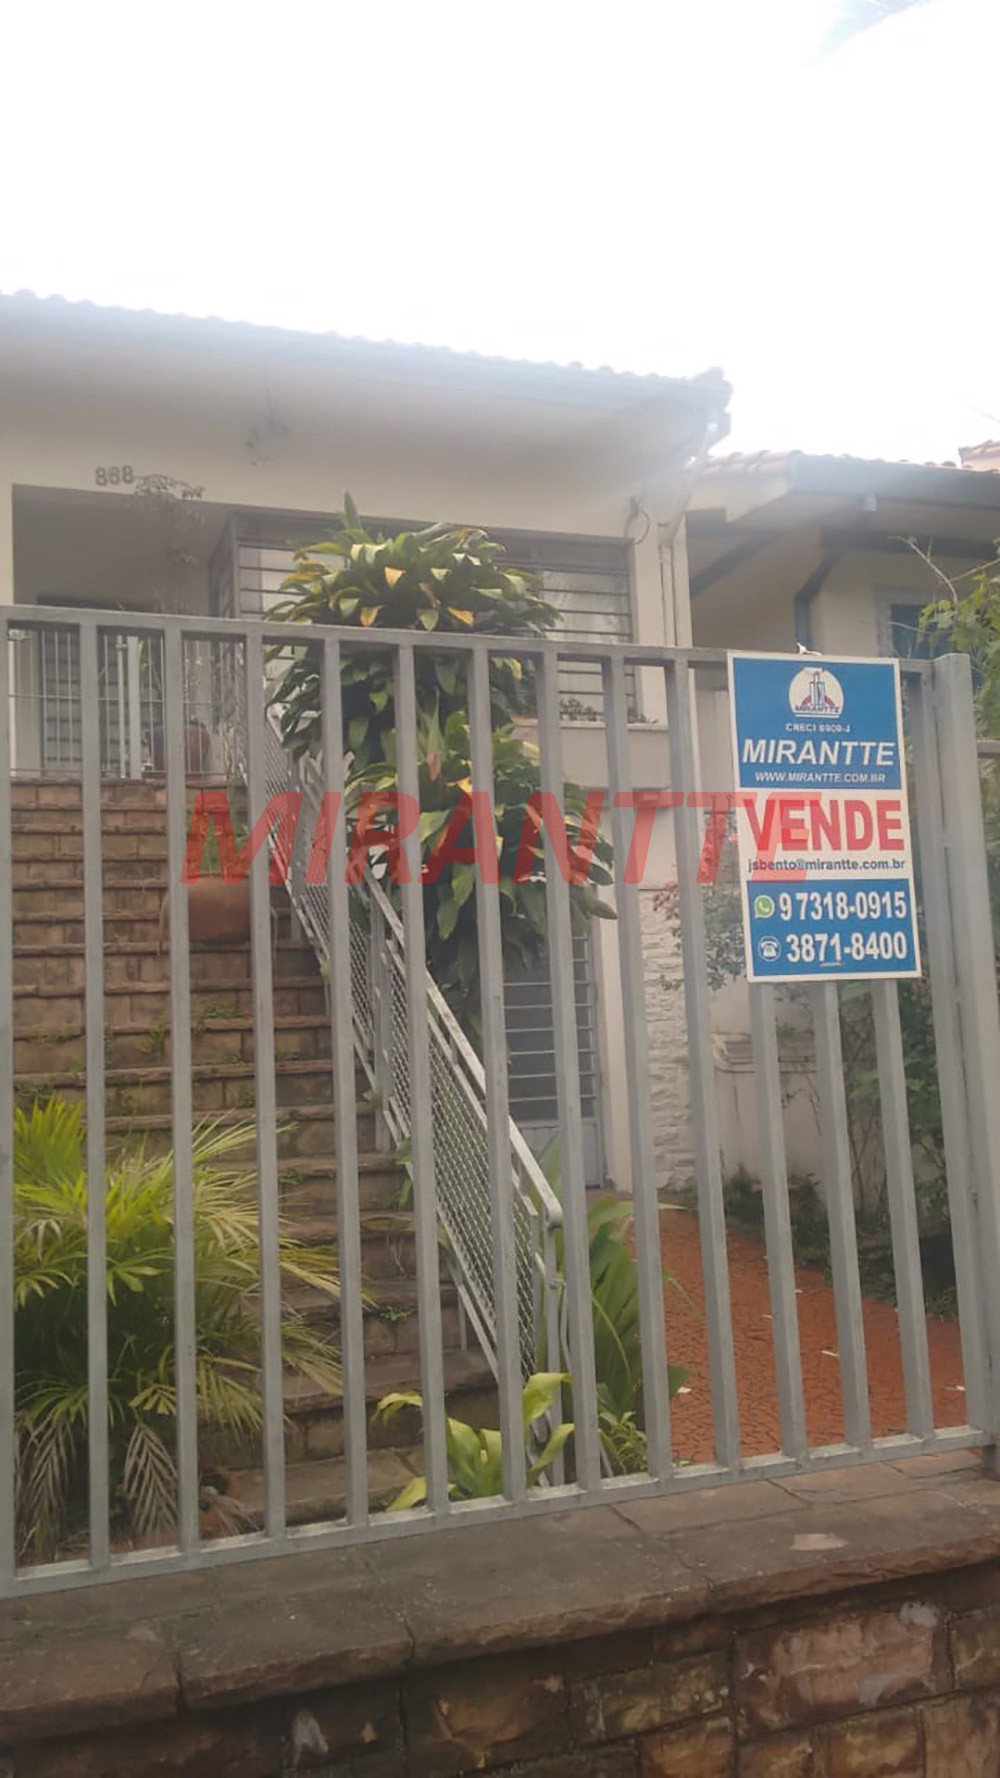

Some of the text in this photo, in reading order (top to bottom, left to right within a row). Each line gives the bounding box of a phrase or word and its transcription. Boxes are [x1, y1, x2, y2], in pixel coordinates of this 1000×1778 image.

[742, 739, 895, 766] MIRANTTE
[743, 799, 905, 851] VENDE
[779, 891, 907, 921] 9 7318-0915
[786, 931, 908, 962] 3871-8400
